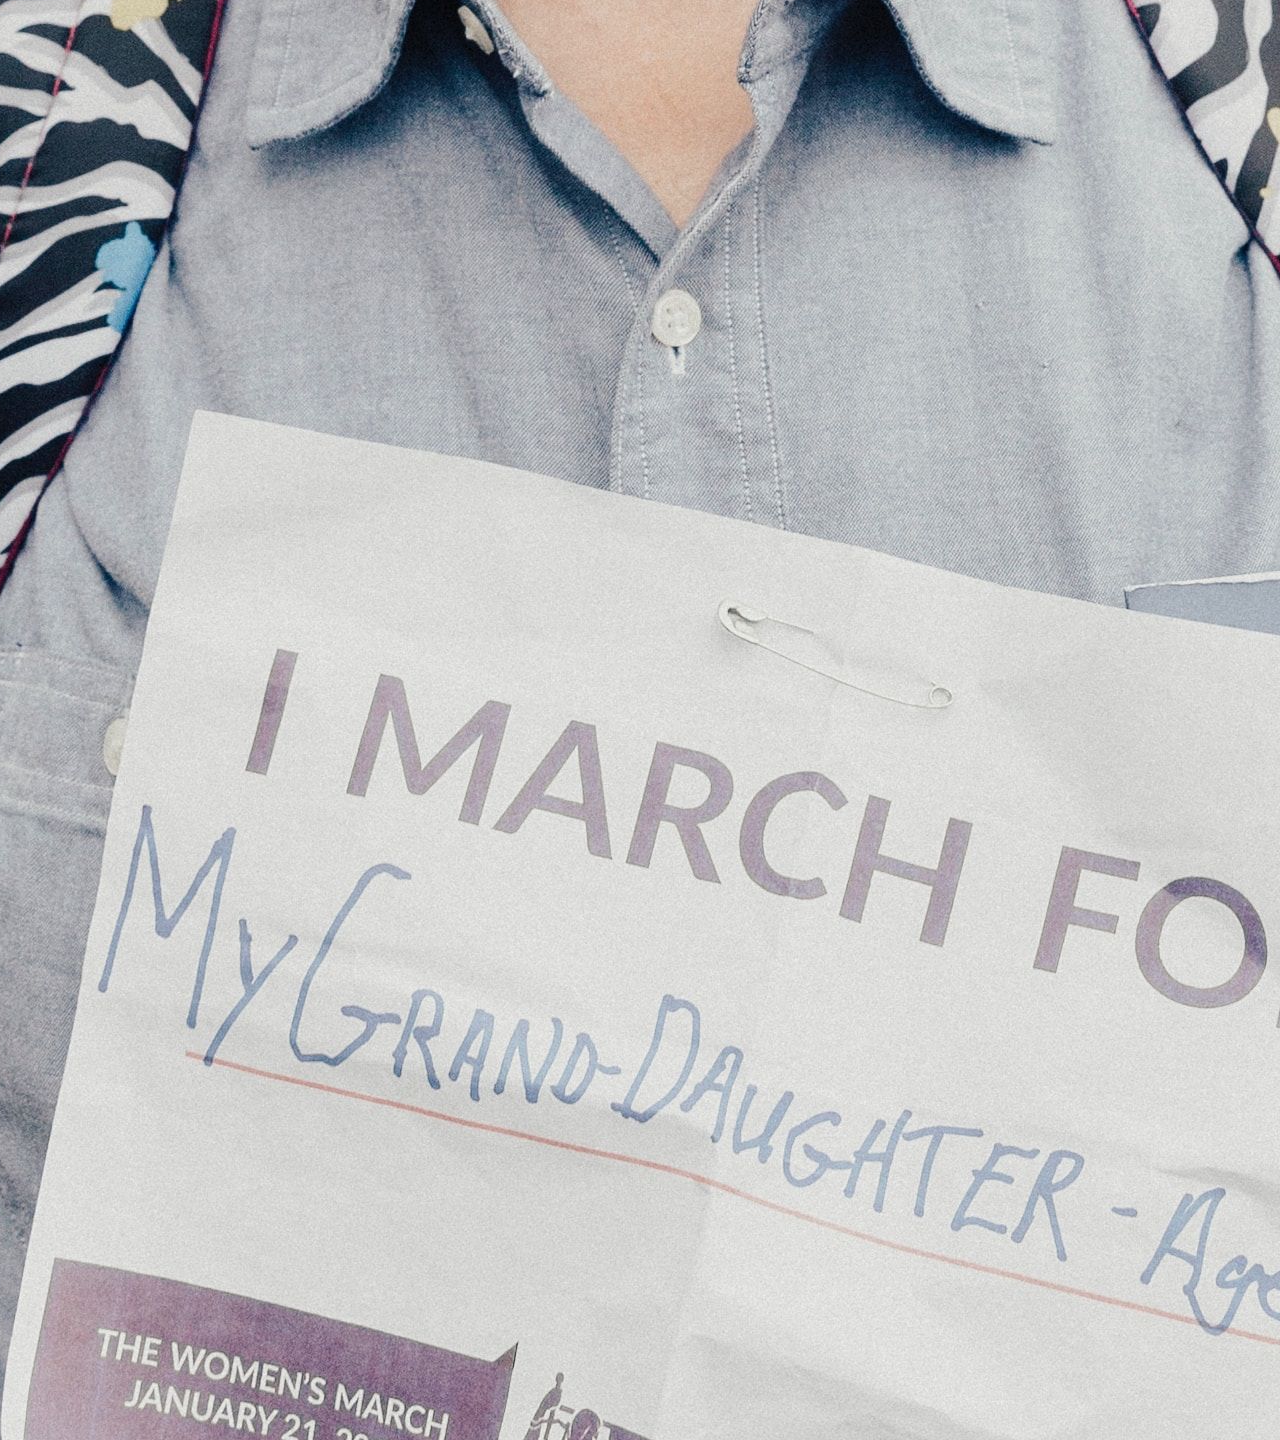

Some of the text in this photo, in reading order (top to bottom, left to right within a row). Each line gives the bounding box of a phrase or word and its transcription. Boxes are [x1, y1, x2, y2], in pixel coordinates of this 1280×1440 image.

[245, 648, 299, 775] I
[345, 673, 973, 947] MARCH
[96, 1328, 160, 1367] THE
[171, 1341, 327, 1405] WOMEN'S
[123, 1379, 280, 1434] JANUARY
